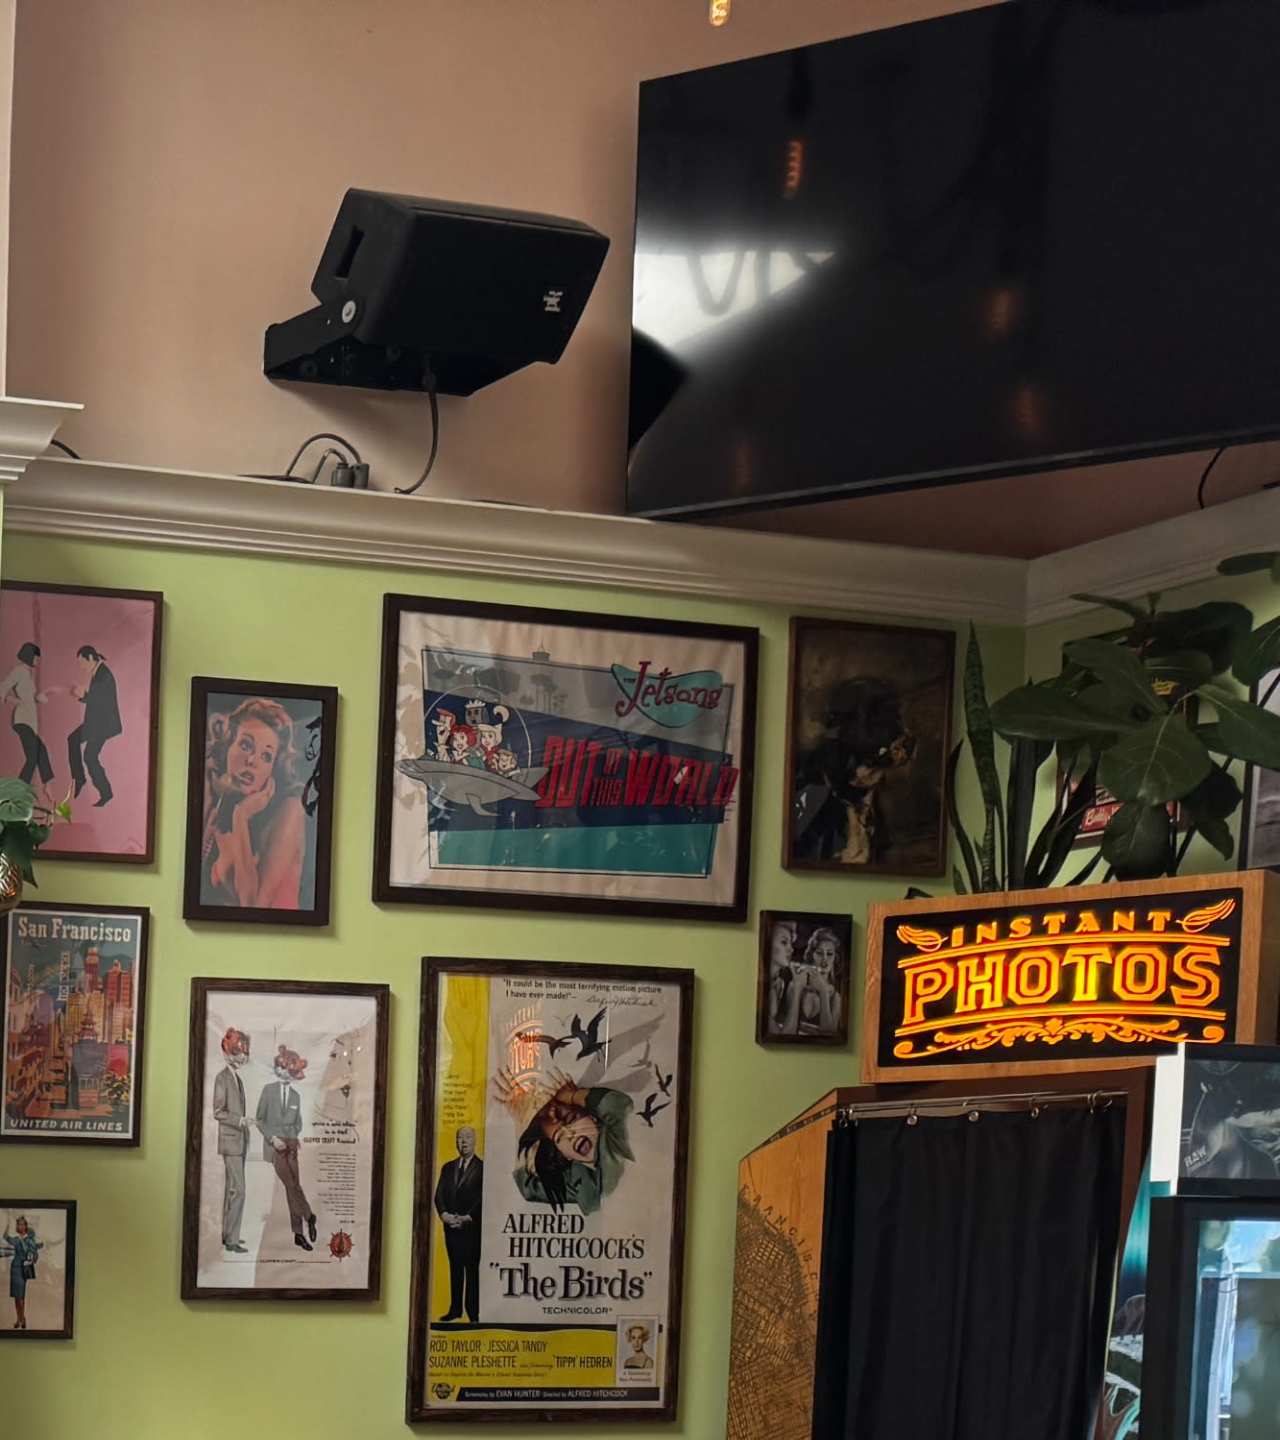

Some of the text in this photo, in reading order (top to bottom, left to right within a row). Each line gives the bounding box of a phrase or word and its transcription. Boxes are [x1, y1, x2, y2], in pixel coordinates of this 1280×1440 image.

[534, 735, 604, 809] OUT
[623, 748, 741, 808] WORLD
[18, 915, 132, 943] San Francisco
[950, 910, 1171, 948] INSTANT
[510, 990, 527, 998] have
[513, 980, 532, 988] could
[534, 980, 543, 988] be
[545, 981, 557, 989] the
[559, 982, 576, 990] most
[578, 982, 610, 993] terrifying
[612, 984, 637, 992] motion
[902, 944, 1222, 1027] PHOTOS
[10, 1118, 123, 1132] UNITED AIR LINES
[502, 1213, 585, 1235] ALFRED
[508, 1234, 645, 1260] HITCHCOCK'S
[429, 1340, 548, 1353] ROD TAYLOR JESSICA TANDY
[428, 1355, 469, 1369] SUZANNE
[471, 1355, 517, 1369] PLESHETTE
[579, 1356, 613, 1369] HEDREN
[514, 1390, 540, 1398] HUNTER
